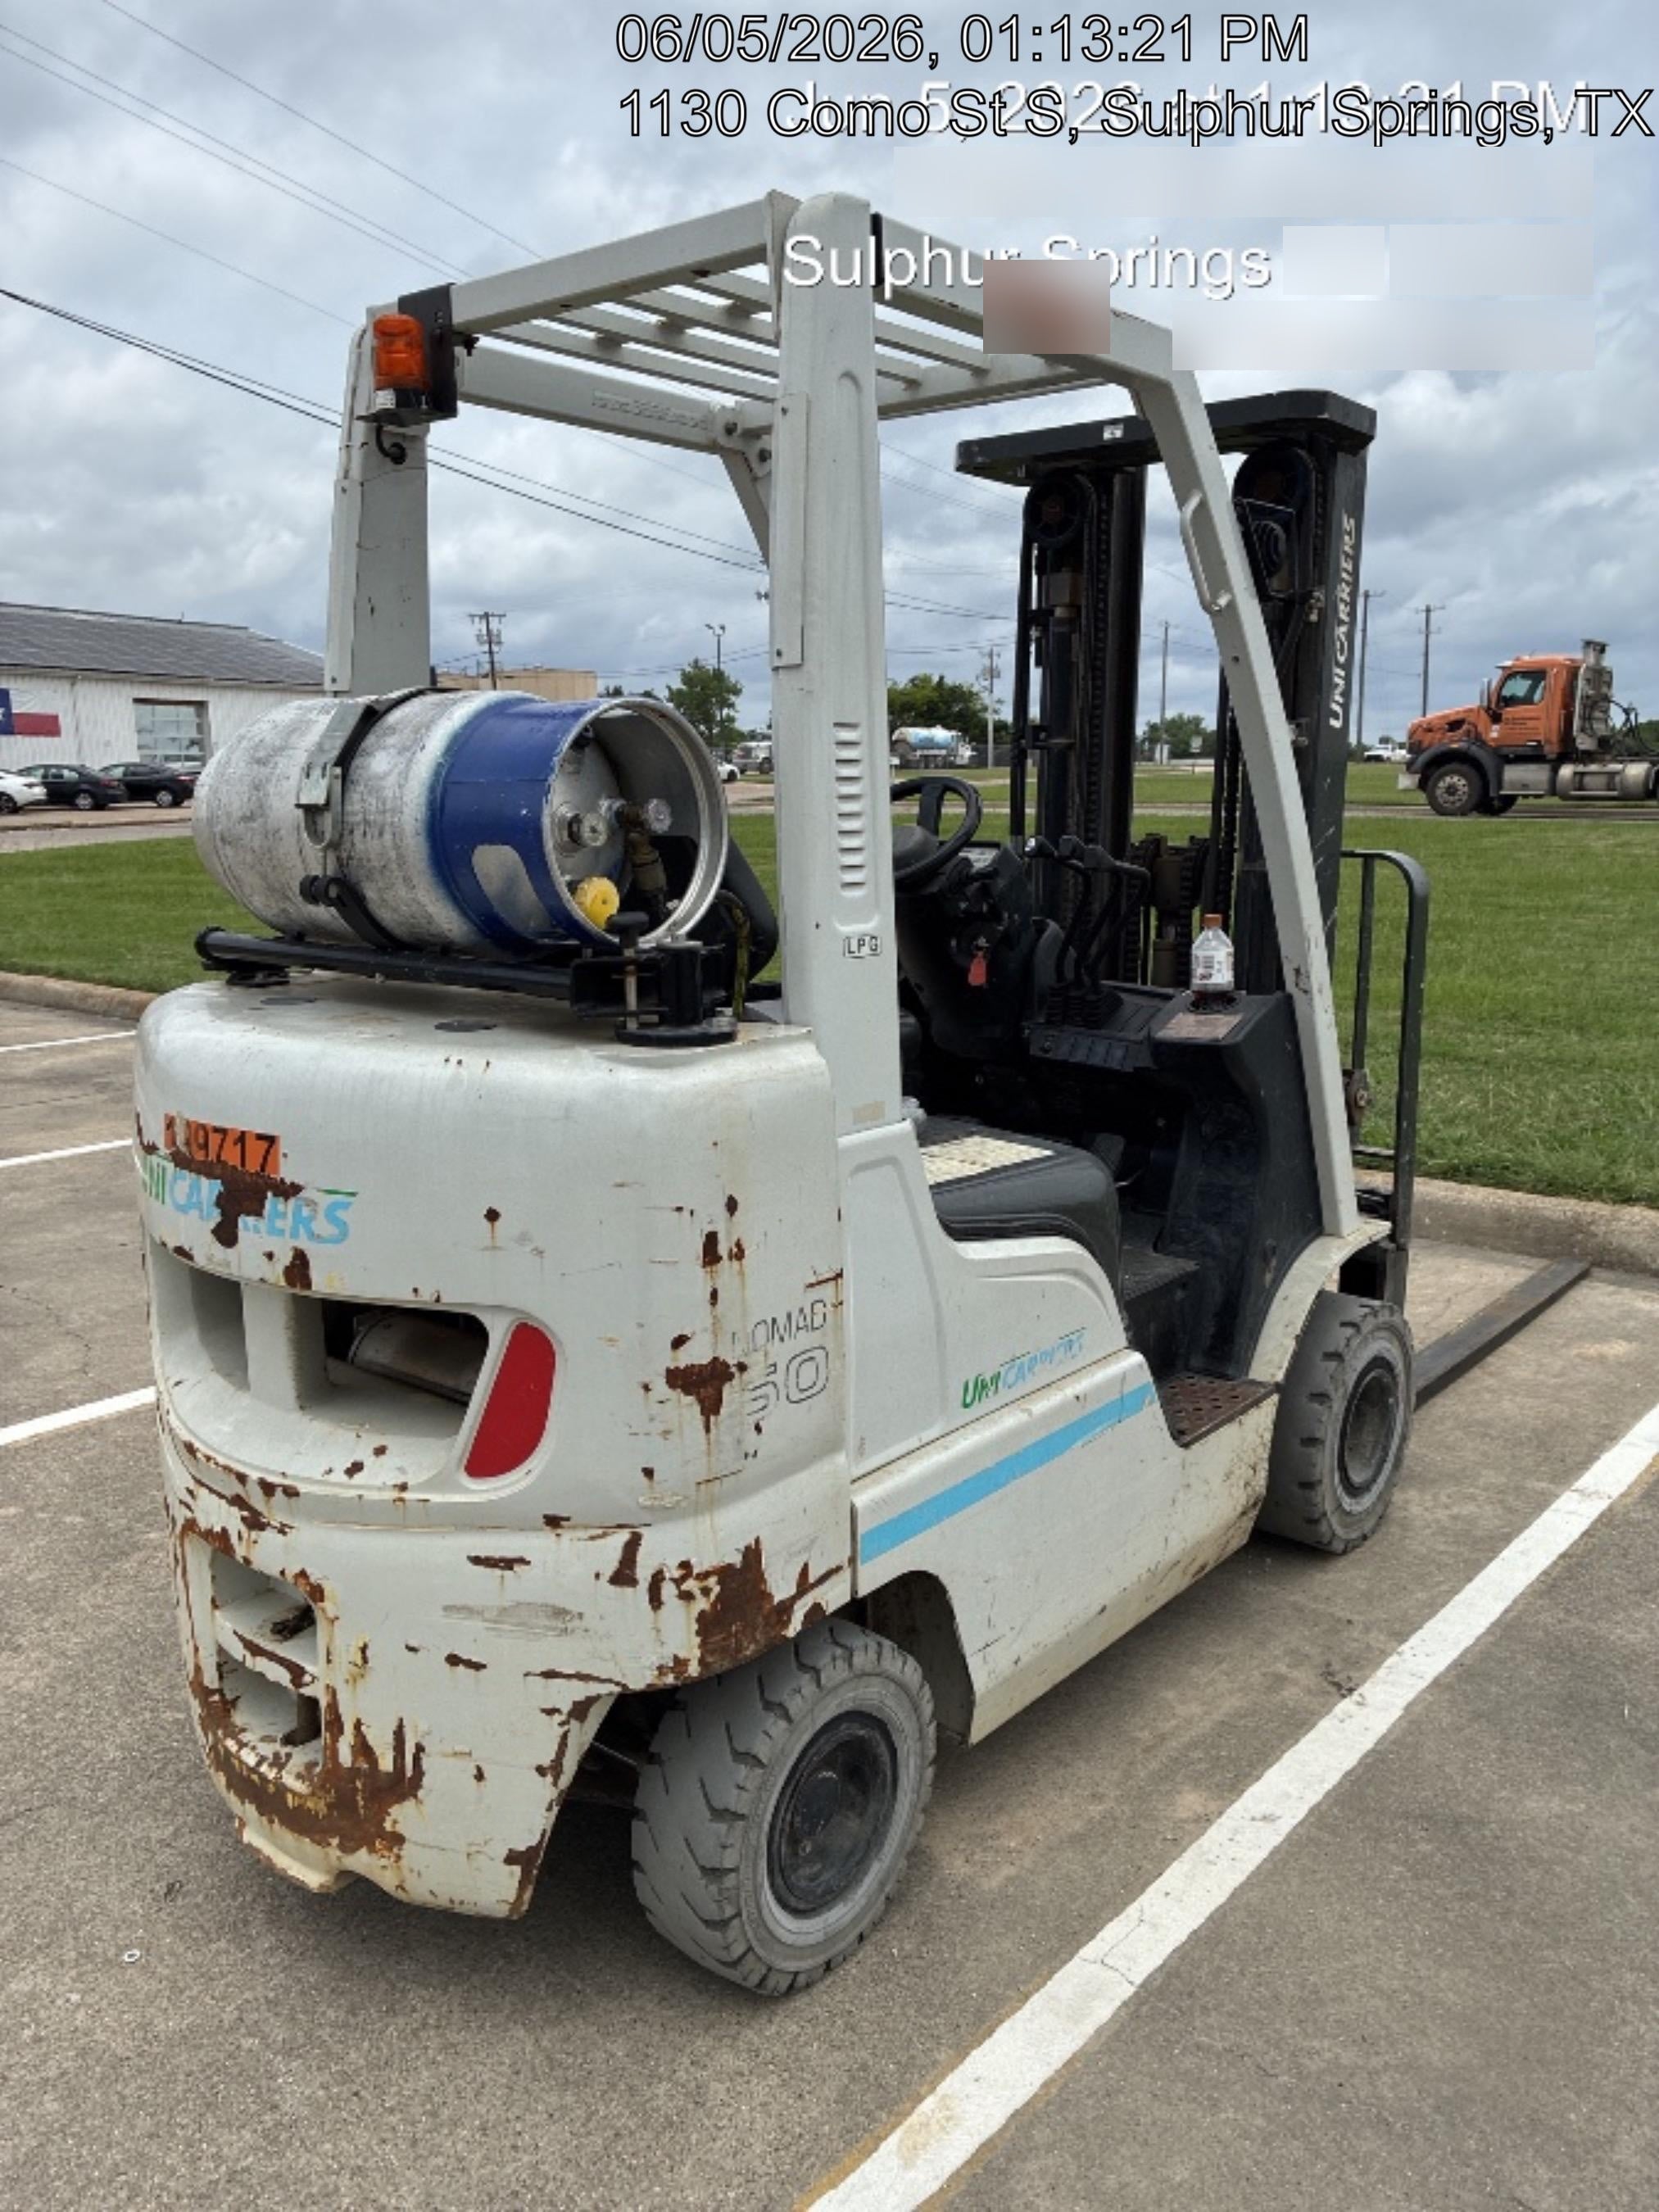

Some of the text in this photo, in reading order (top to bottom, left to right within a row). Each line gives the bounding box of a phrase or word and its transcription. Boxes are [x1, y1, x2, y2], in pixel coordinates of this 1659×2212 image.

[1329, 508, 1356, 728] UNICARRIERS
[846, 936, 879, 955] LPG
[165, 1114, 279, 1172] 19717
[732, 1299, 827, 1357] OMAD
